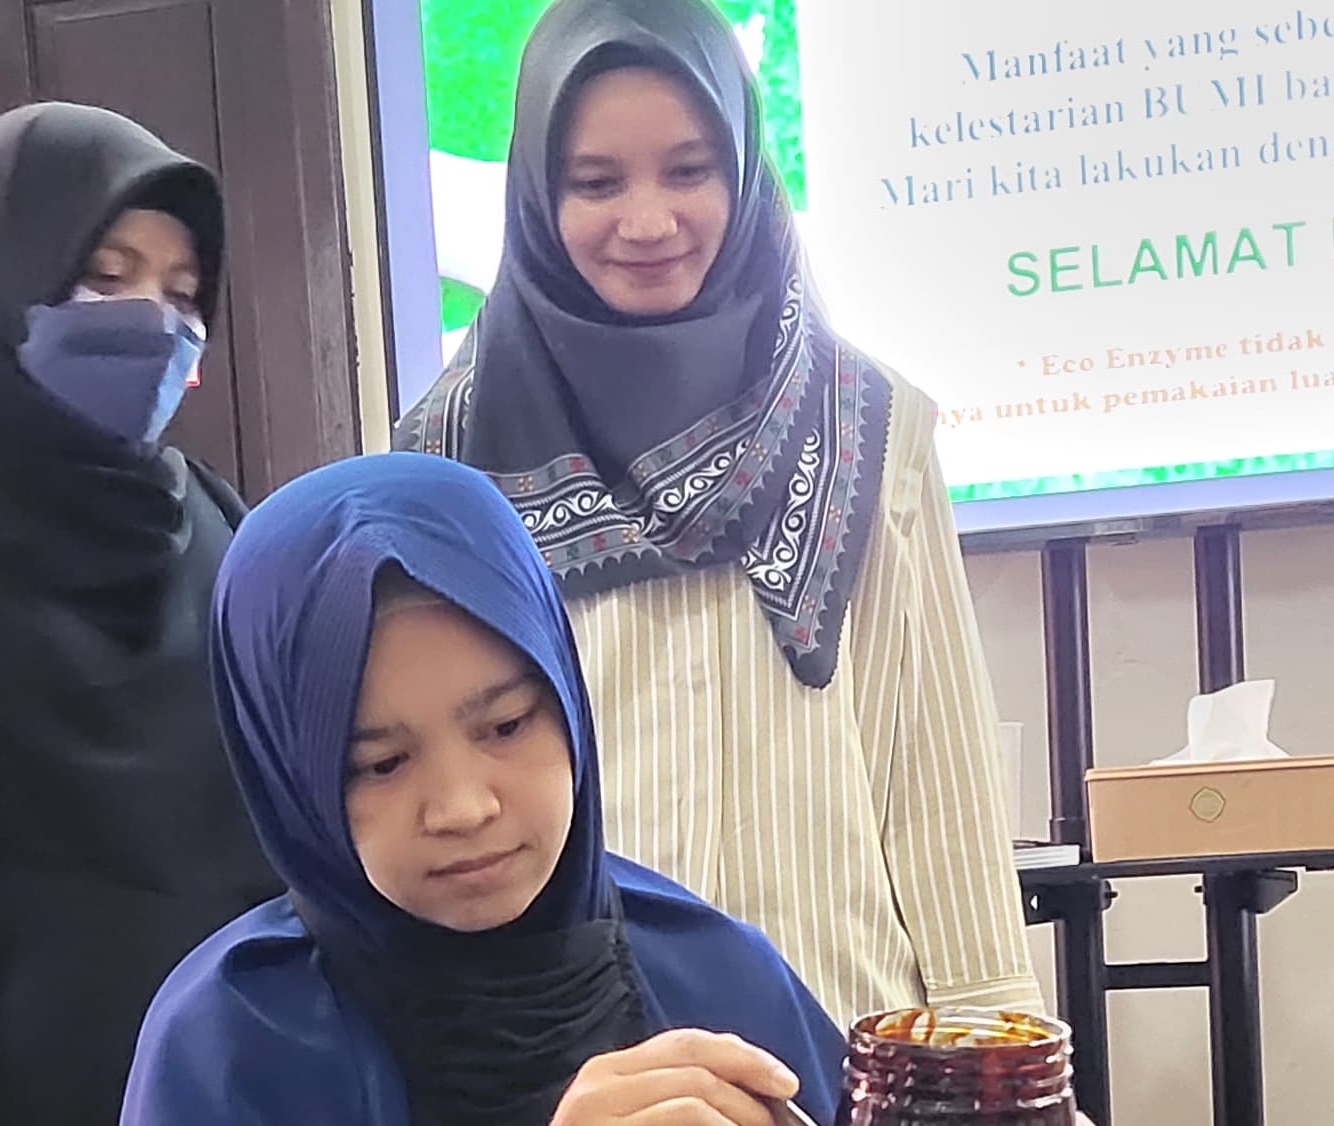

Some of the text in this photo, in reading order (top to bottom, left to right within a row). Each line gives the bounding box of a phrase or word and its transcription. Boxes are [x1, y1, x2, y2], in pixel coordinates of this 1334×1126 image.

[961, 38, 1126, 86] Manfaat
[1142, 28, 1239, 70] yang
[909, 97, 1125, 148] kelestarian
[880, 167, 975, 211] Mari
[990, 161, 1063, 197] kita
[1079, 143, 1242, 186] lakukan
[1006, 220, 1306, 297] SELAMAT
[1041, 353, 1095, 377] Eco
[1106, 342, 1229, 370] Enzyme
[1239, 328, 1325, 356] tidak
[995, 391, 1093, 421] untuk
[1101, 375, 1279, 415] pemakaian
